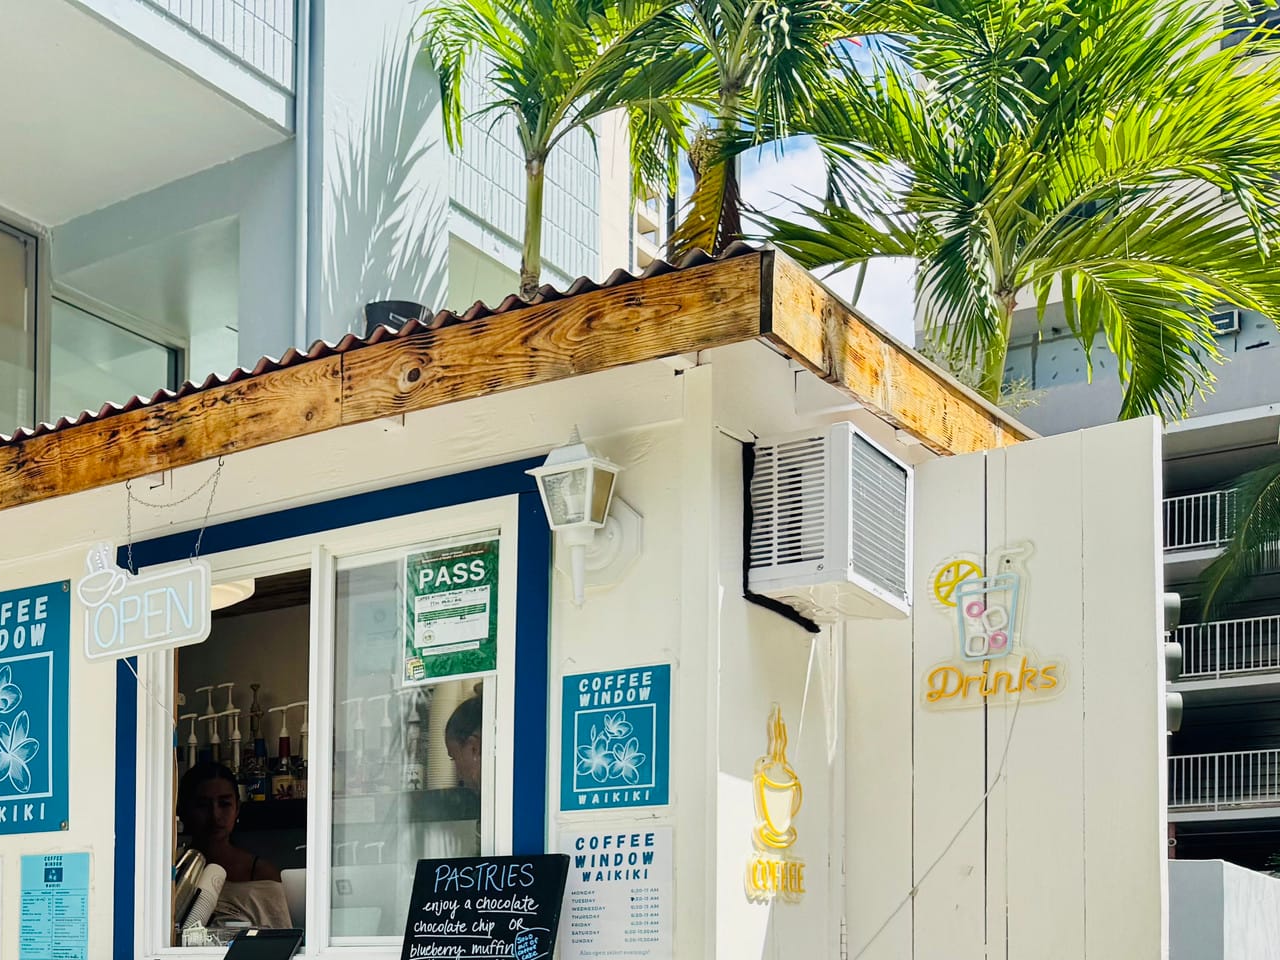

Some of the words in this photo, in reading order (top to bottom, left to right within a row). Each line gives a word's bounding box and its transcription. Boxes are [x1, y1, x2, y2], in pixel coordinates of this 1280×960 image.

[419, 559, 485, 589] PASS
[94, 581, 193, 648] OPEN
[578, 671, 653, 693] COFFEE
[926, 656, 1057, 702] Drinks
[578, 686, 651, 707] WINDOW
[578, 790, 650, 805] WAIKIKI
[575, 833, 655, 851] COFFEE
[575, 851, 654, 869] WINDOW
[434, 862, 535, 893] PASTRIES
[582, 869, 648, 882] WAIKIKI
[422, 899, 460, 919] enjoy
[464, 900, 471, 910] a
[475, 894, 540, 912] chocolate
[413, 920, 467, 936] chocolate
[471, 918, 496, 937] chip
[508, 918, 526, 930] OR
[471, 939, 515, 957] muffin
